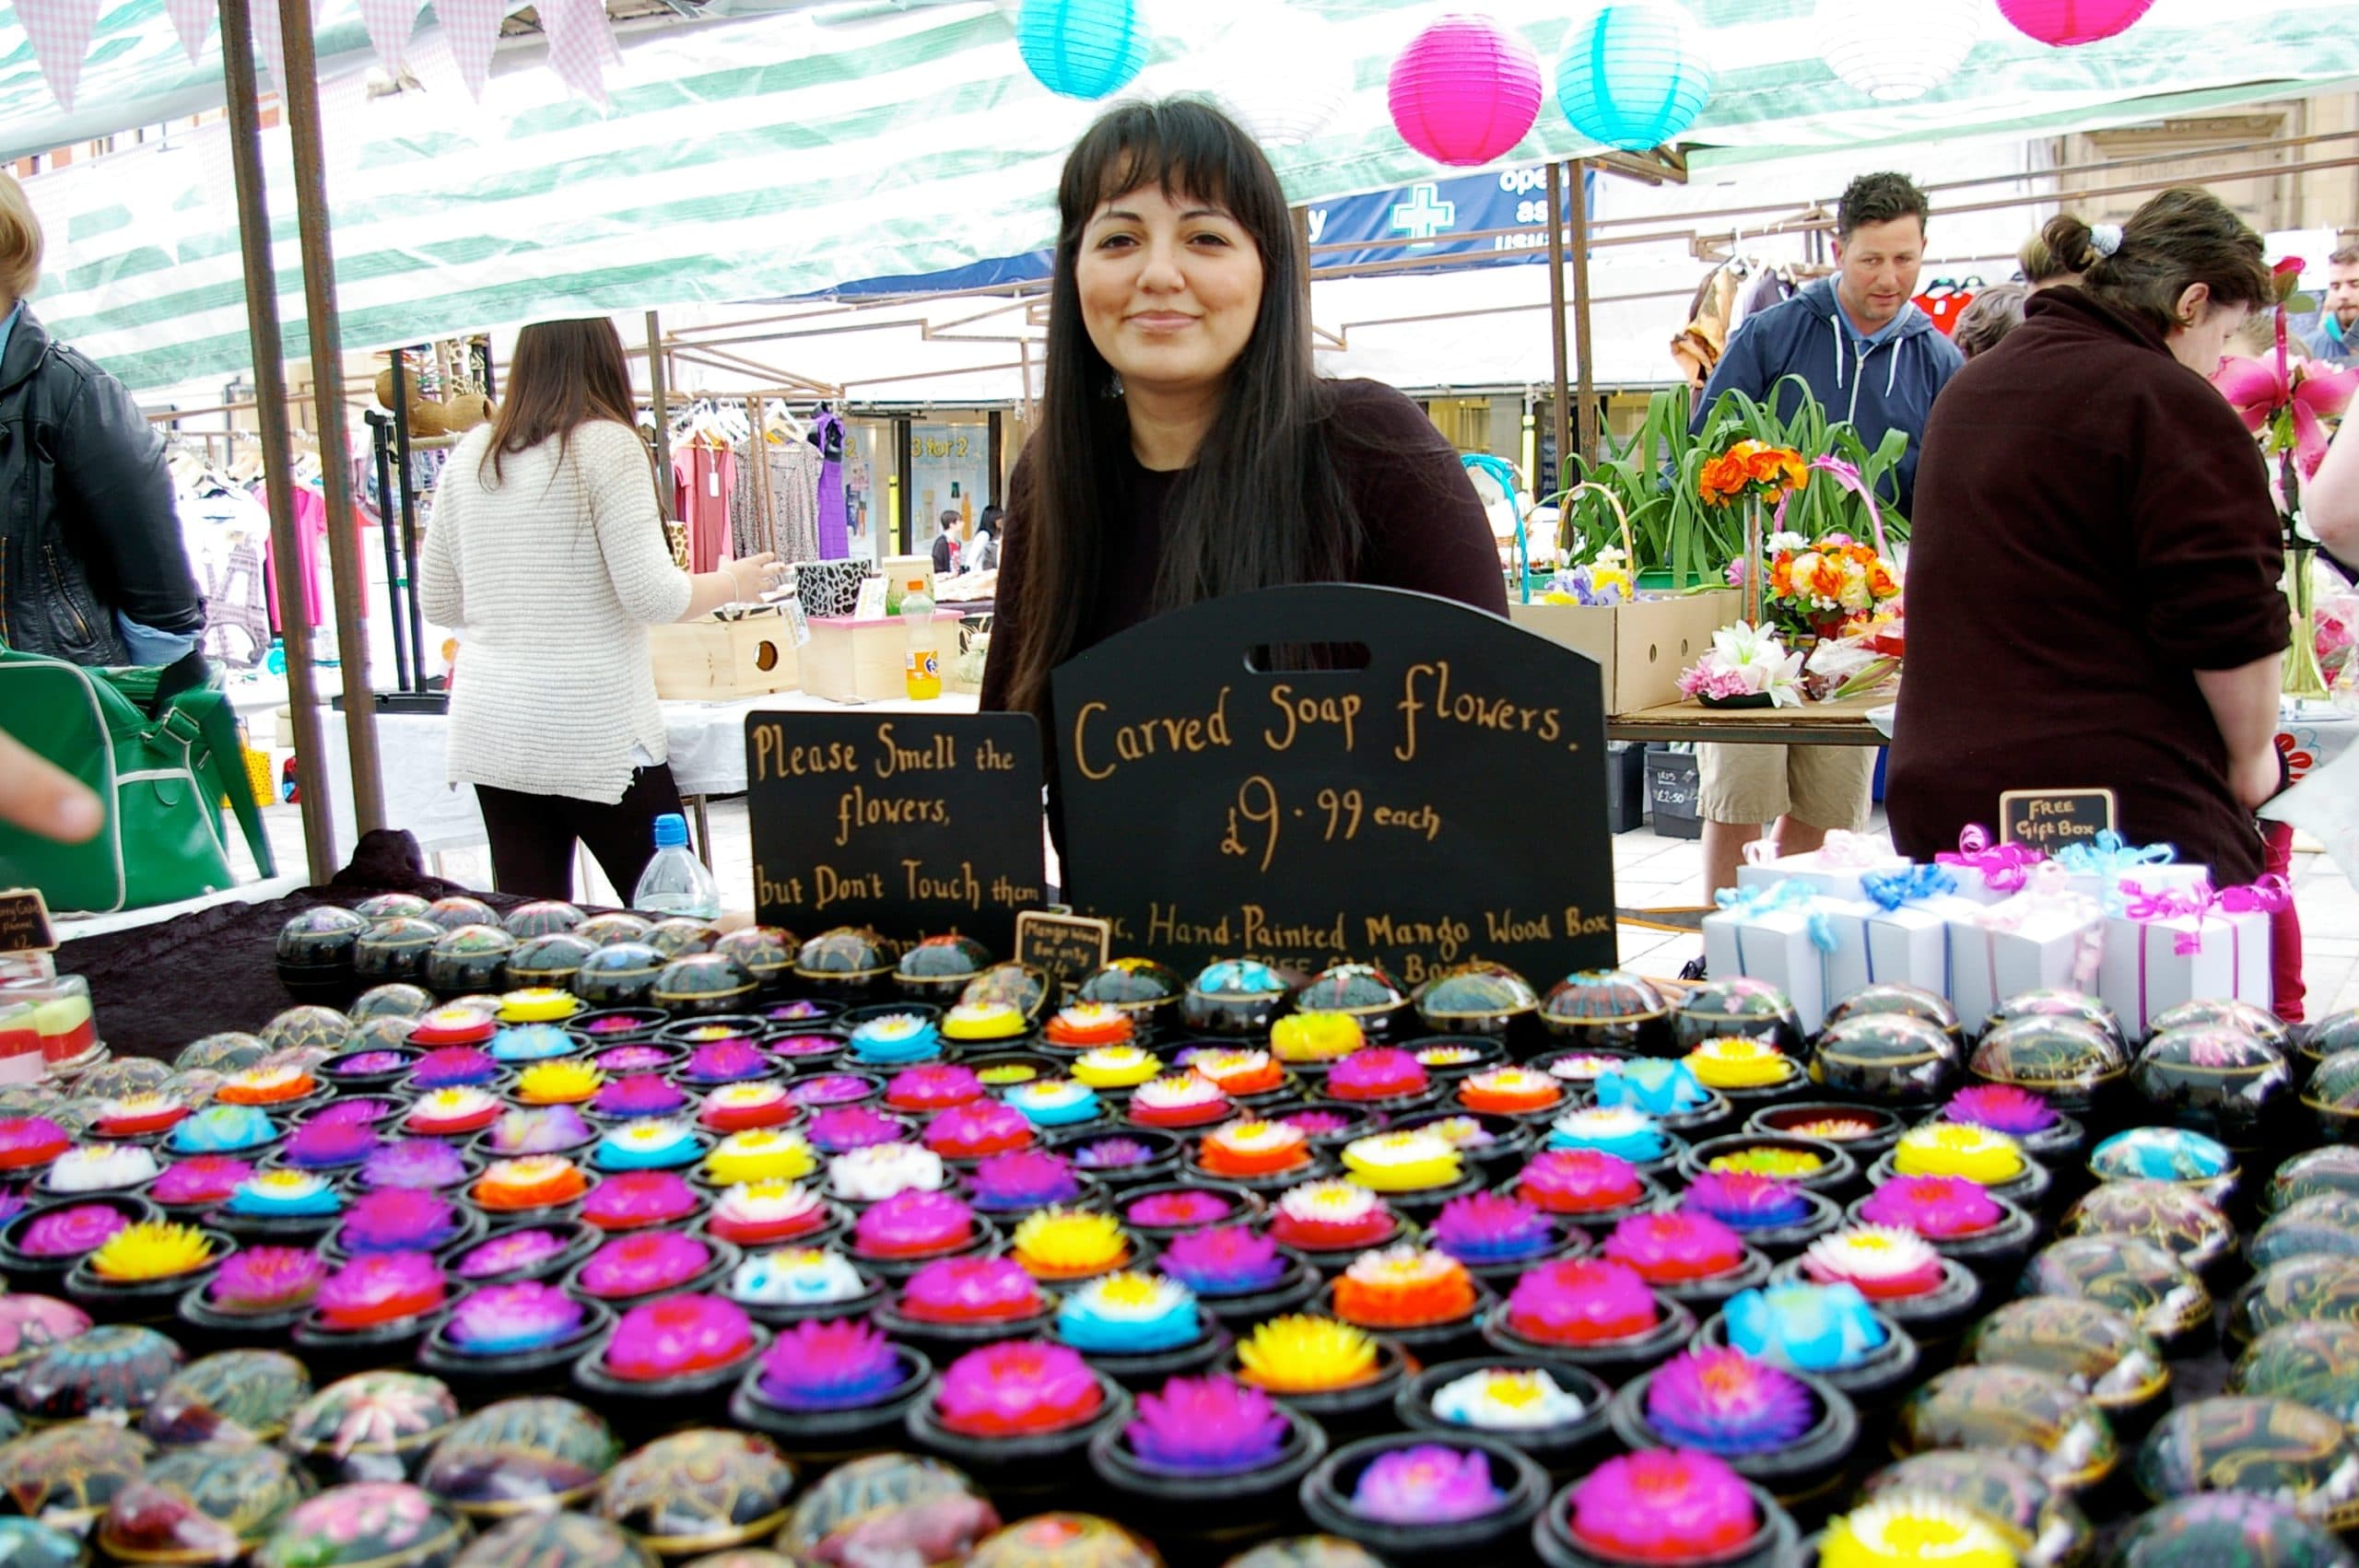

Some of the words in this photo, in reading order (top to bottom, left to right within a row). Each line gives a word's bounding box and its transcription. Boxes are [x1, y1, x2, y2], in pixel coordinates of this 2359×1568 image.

[912, 437, 922, 458] 3
[927, 437, 953, 458] for
[957, 436, 968, 458] 2
[752, 724, 858, 780] Please
[875, 722, 957, 778] Smell
[976, 739, 1015, 770] the
[1074, 686, 1231, 779] Carved
[1264, 685, 1361, 751] Soap
[1374, 805, 1440, 841] each
[2016, 821, 2056, 841] Gift
[2058, 820, 2095, 837] Box
[2029, 800, 2074, 820] FREE
[755, 864, 804, 907] but
[815, 865, 884, 910] Don't
[902, 859, 980, 910] Touch
[991, 876, 1039, 907] them
[1365, 914, 1471, 962] Mango
[1485, 908, 1553, 943] Wood
[1565, 907, 1611, 937] Box
